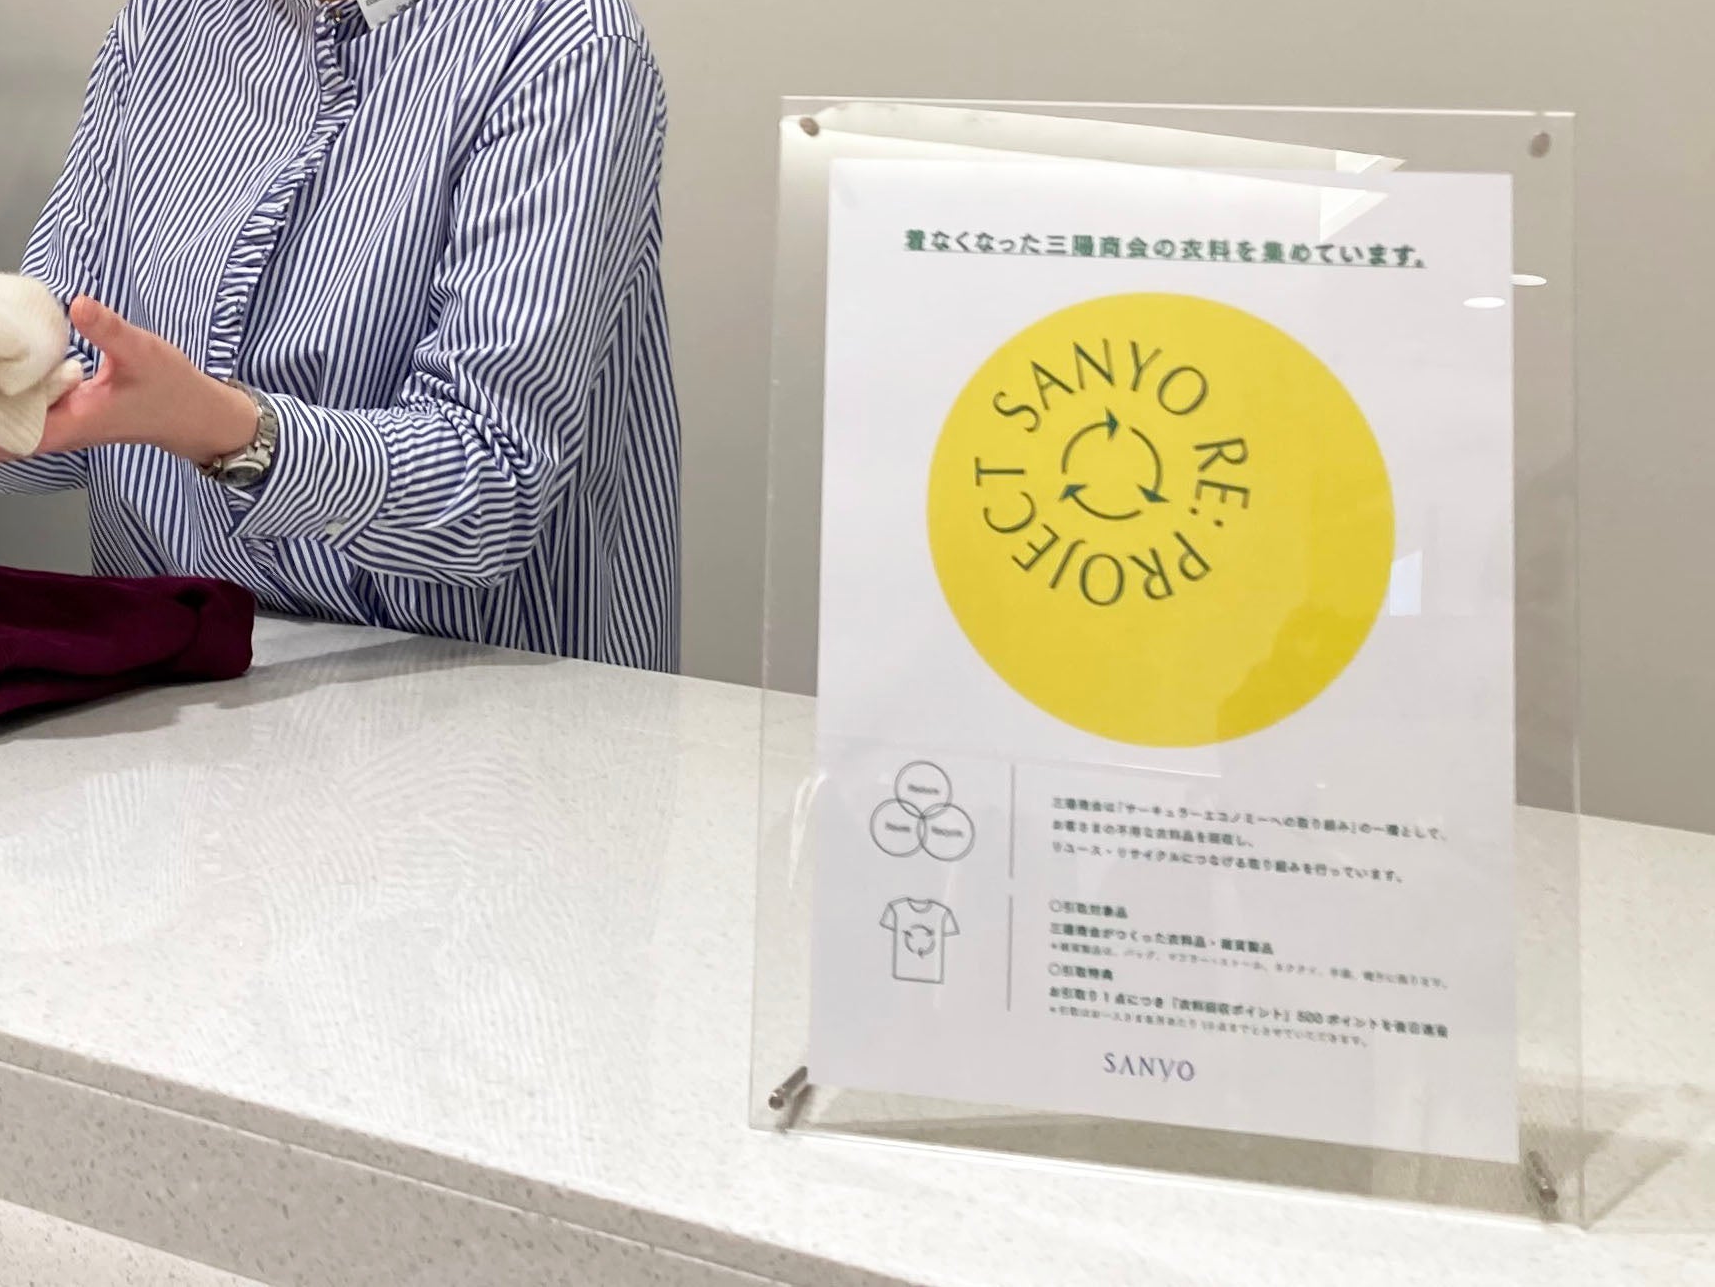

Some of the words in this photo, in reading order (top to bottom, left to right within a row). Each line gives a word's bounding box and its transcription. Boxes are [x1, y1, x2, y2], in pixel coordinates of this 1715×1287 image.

[904, 228, 1425, 268] 着なくなった三陽商会の衣料を集めています。
[992, 338, 1209, 433] SANYO
[1190, 437, 1251, 528] RE:
[973, 456, 1212, 607] PROJECT
[1103, 1052, 1196, 1082] SANYO
